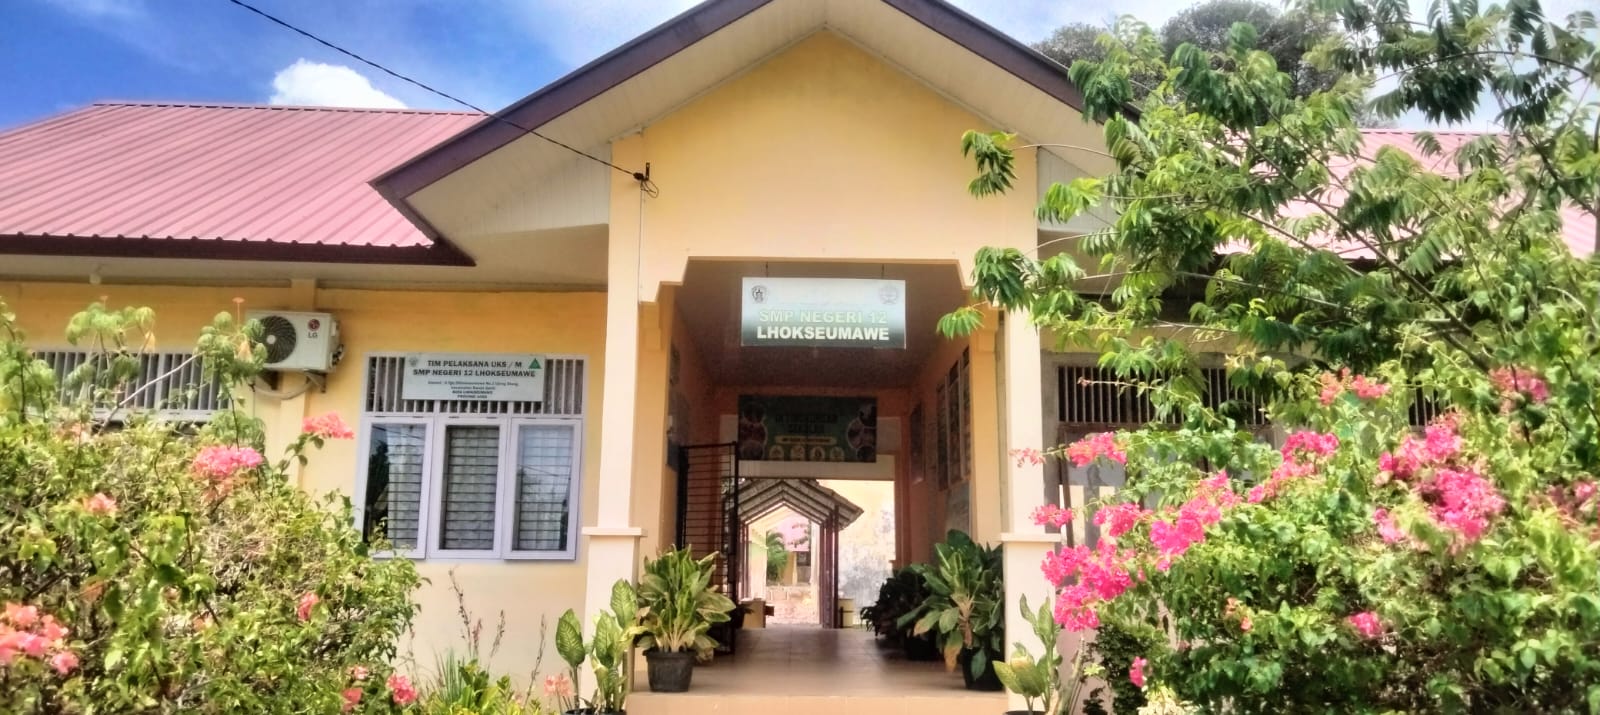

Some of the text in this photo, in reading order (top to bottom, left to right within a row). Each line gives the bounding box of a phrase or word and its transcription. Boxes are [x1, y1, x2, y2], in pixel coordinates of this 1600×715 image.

[759, 310, 888, 324] SMP NEGERI 12
[757, 326, 890, 341] LHOKSEUMAWE
[443, 360, 489, 368] PELAKSANA
[491, 360, 507, 368] UKS
